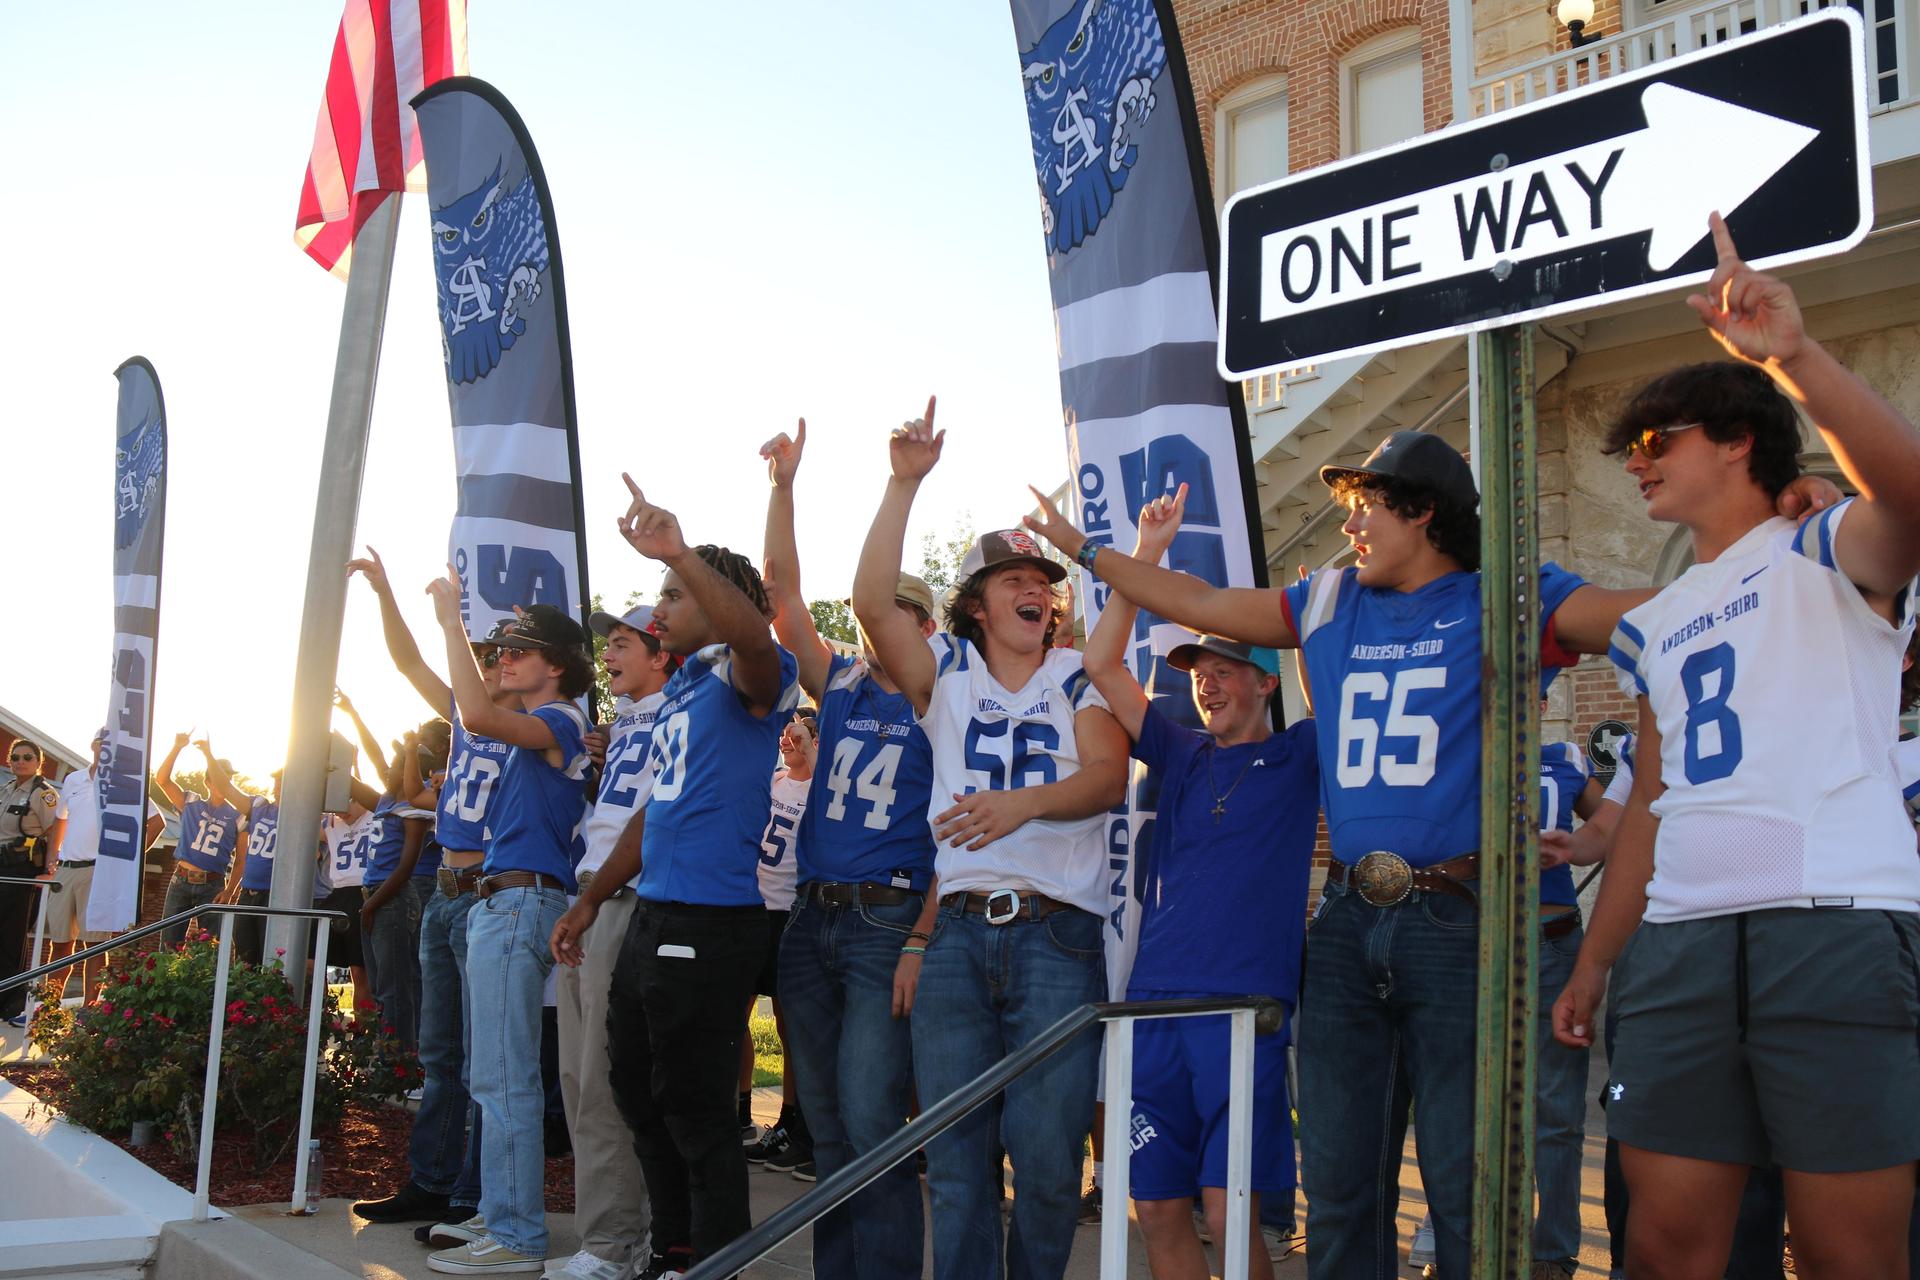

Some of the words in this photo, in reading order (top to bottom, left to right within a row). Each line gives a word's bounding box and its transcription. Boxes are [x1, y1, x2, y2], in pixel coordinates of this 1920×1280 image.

[1280, 204, 1422, 303] ONE
[1454, 148, 1625, 261] WAY
[1351, 638, 1444, 660] ANDERSON-SHIRO
[1660, 592, 1759, 656] ANDERSON-SHIRO
[1336, 667, 1447, 789] 65
[1680, 641, 1743, 785] 8
[825, 736, 904, 831] 44
[964, 716, 1060, 796] 56
[190, 820, 224, 857] 12
[248, 822, 277, 859] 60
[336, 835, 369, 871] 54
